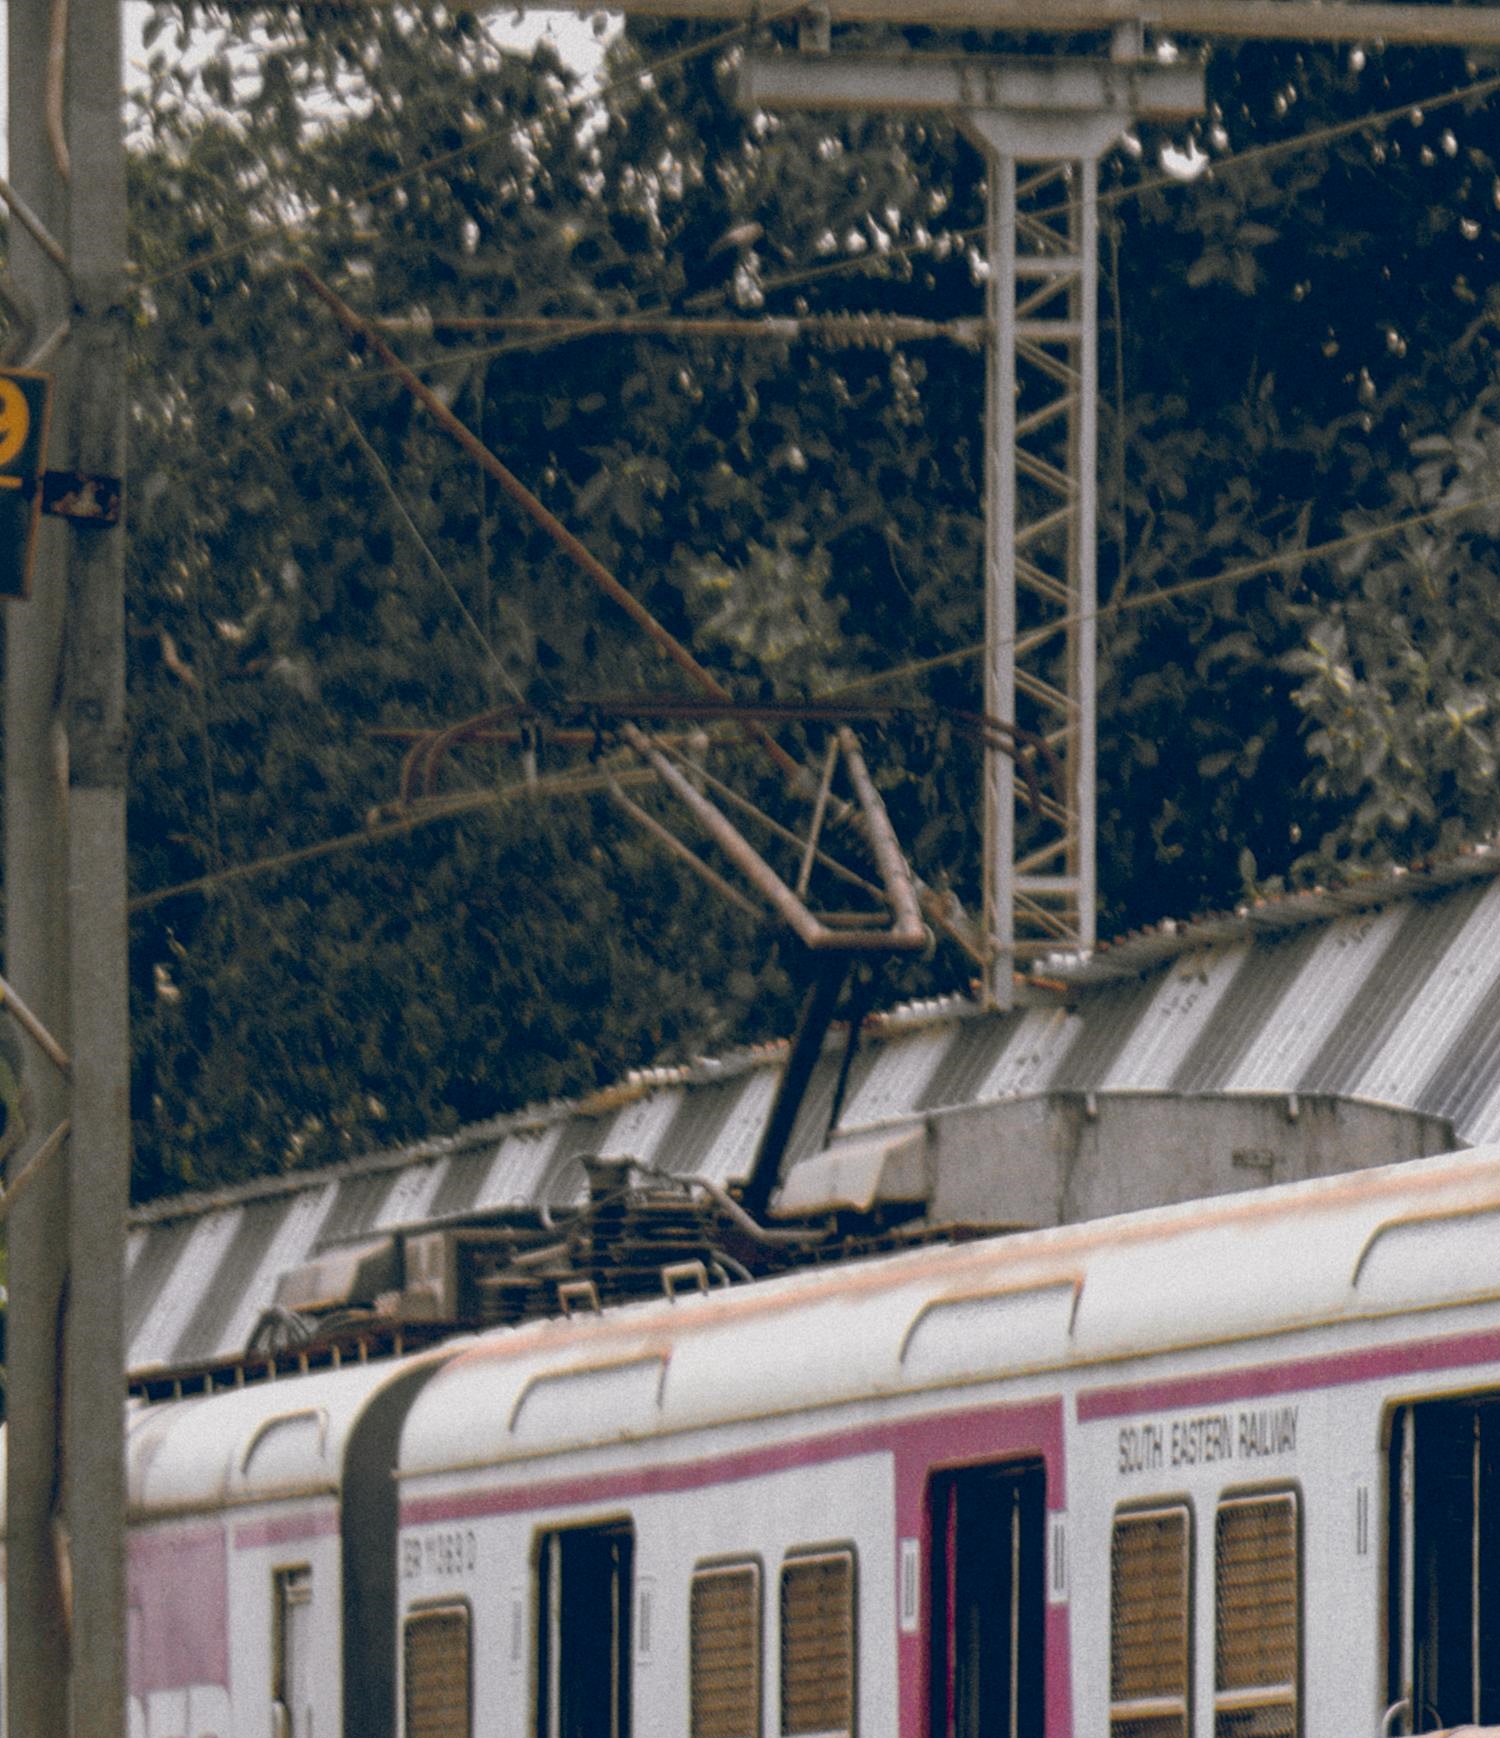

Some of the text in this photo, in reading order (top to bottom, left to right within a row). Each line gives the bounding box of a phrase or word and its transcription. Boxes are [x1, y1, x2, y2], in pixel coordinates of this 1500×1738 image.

[1118, 1405, 1300, 1475] SOUTH EASTERN RAILWAY
